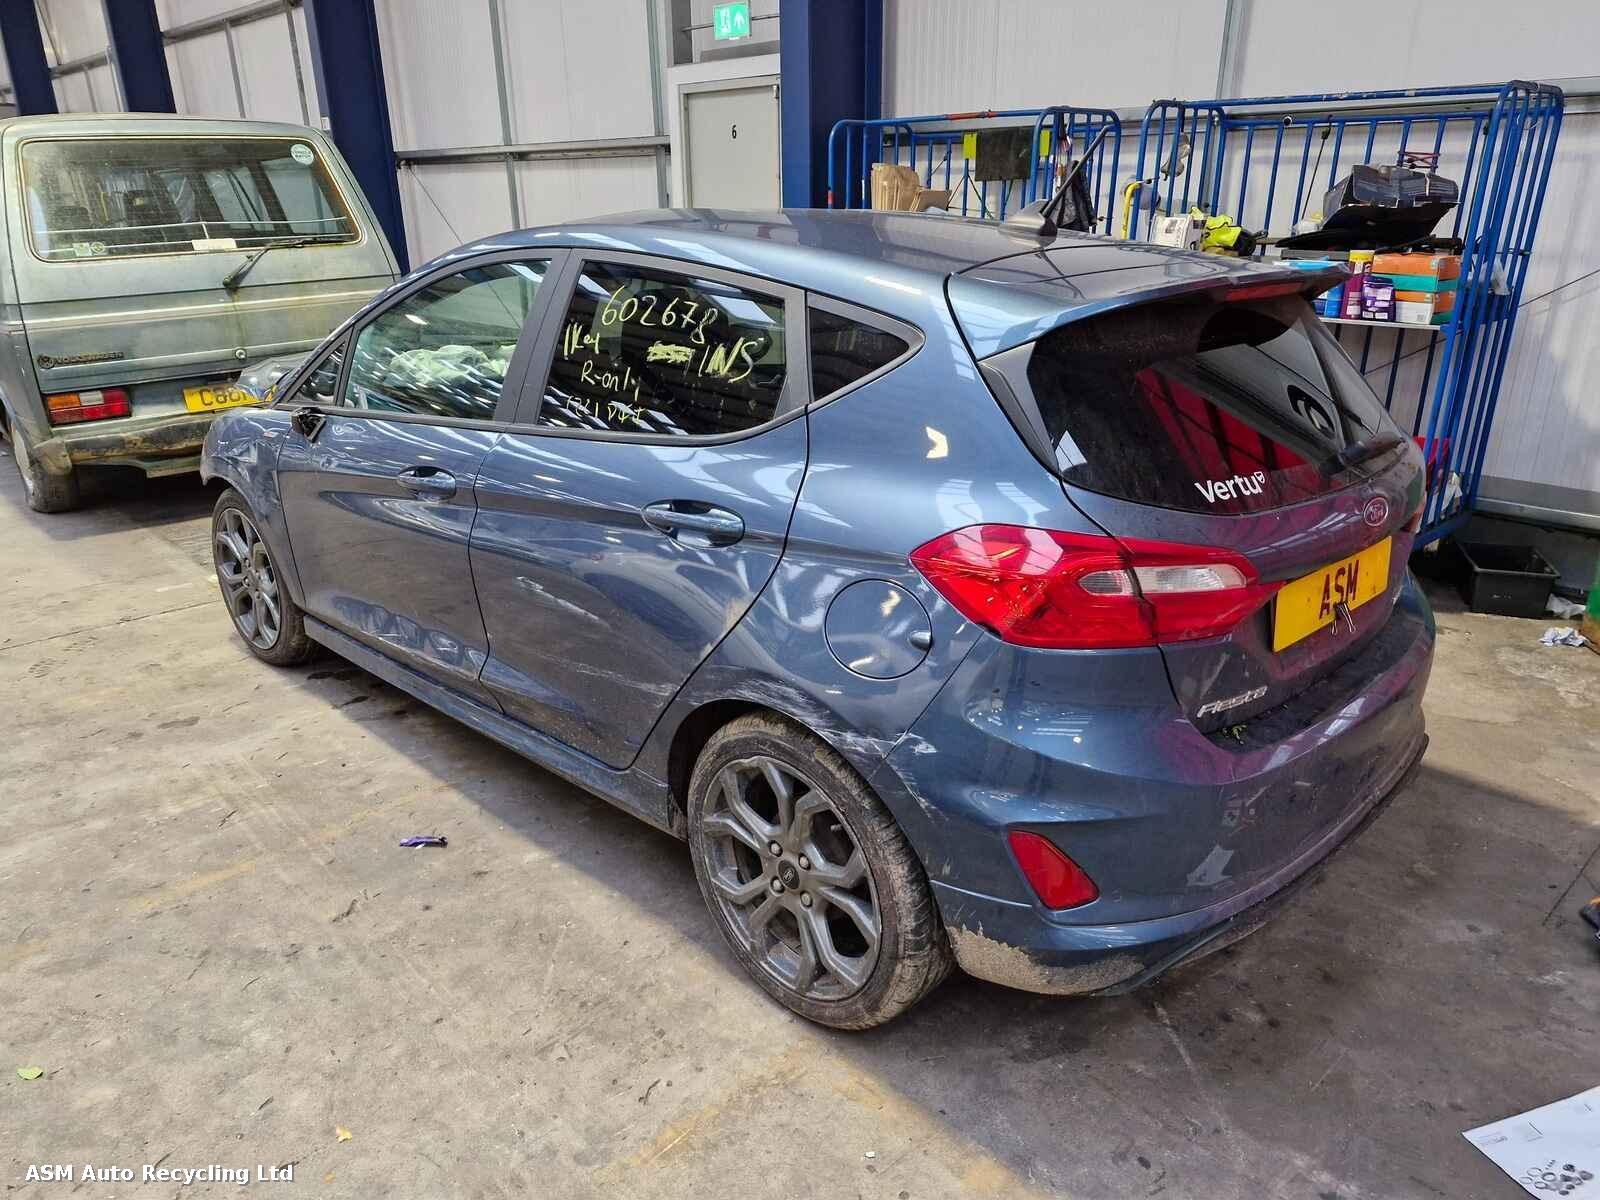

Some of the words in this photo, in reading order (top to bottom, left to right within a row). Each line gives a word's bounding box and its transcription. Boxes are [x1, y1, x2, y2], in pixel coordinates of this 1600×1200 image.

[731, 124, 737, 139] 6
[1194, 472, 1262, 504] Vertu
[1318, 559, 1360, 619] ASM
